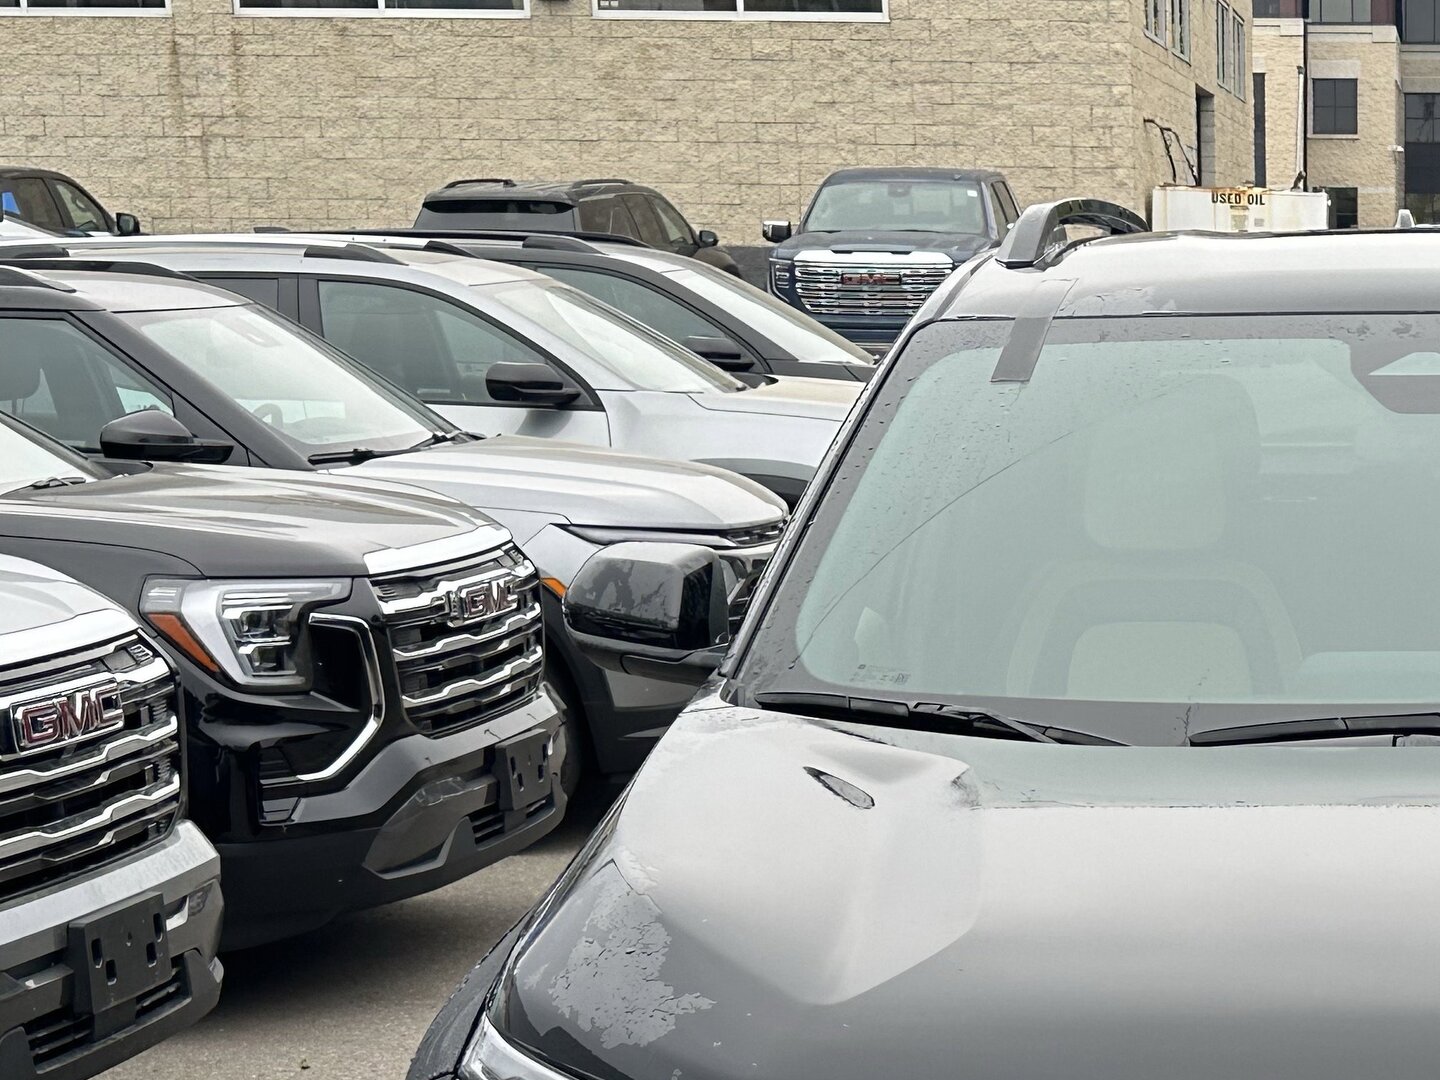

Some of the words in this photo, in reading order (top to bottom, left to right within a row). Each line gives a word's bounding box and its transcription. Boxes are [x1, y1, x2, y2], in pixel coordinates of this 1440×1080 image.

[1211, 192, 1241, 205] USED
[1247, 193, 1266, 206] OIL
[460, 576, 518, 618] GMC
[15, 683, 124, 747] GMC
